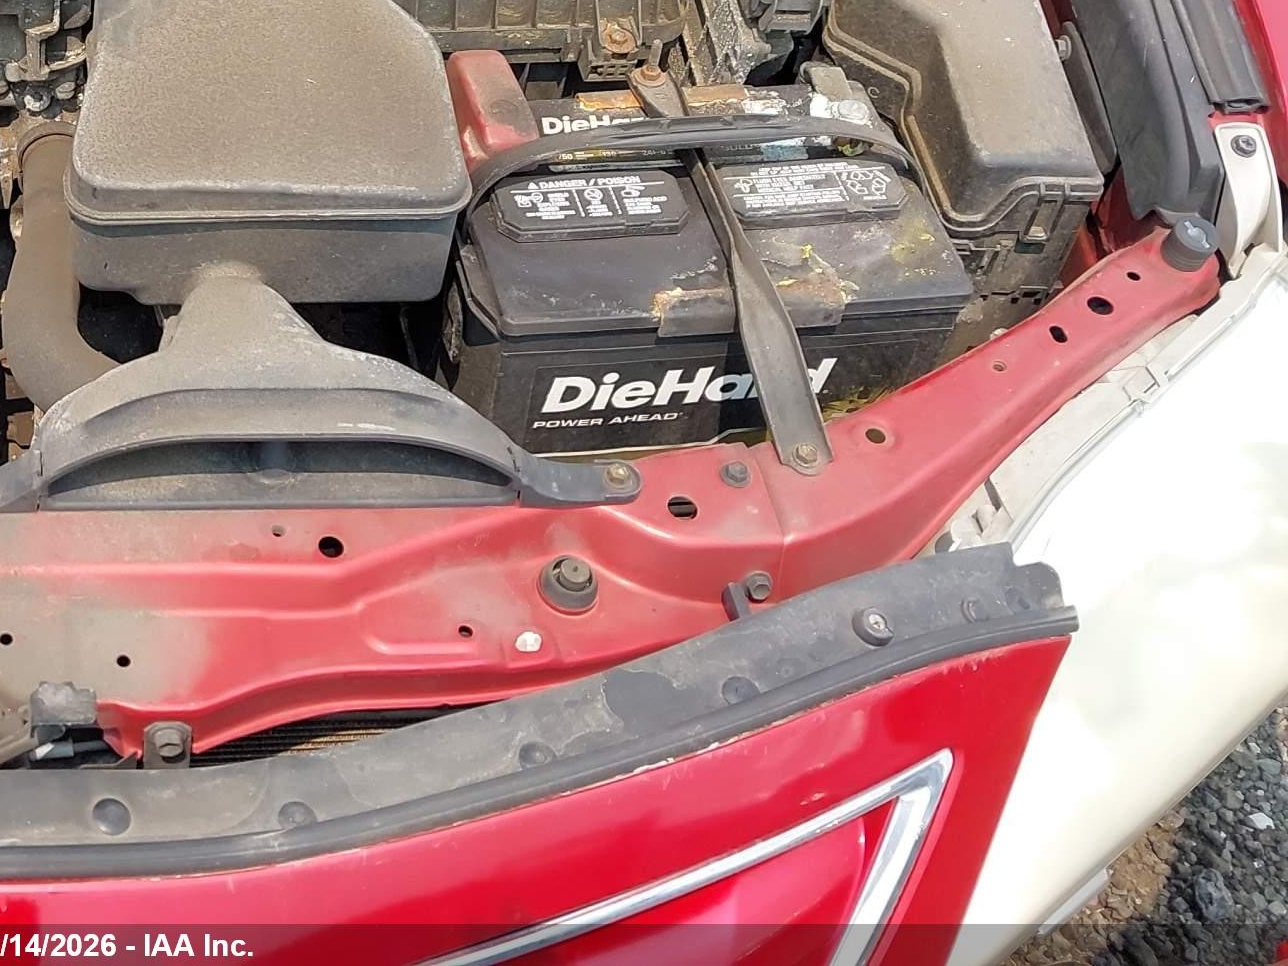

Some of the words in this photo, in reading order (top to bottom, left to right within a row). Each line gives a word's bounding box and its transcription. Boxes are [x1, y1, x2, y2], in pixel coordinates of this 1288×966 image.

[538, 178, 588, 190] DANGER
[597, 175, 641, 186] POISON
[541, 357, 838, 413] DieHad
[531, 418, 604, 429] POWER
[610, 412, 680, 425] AHEAD
